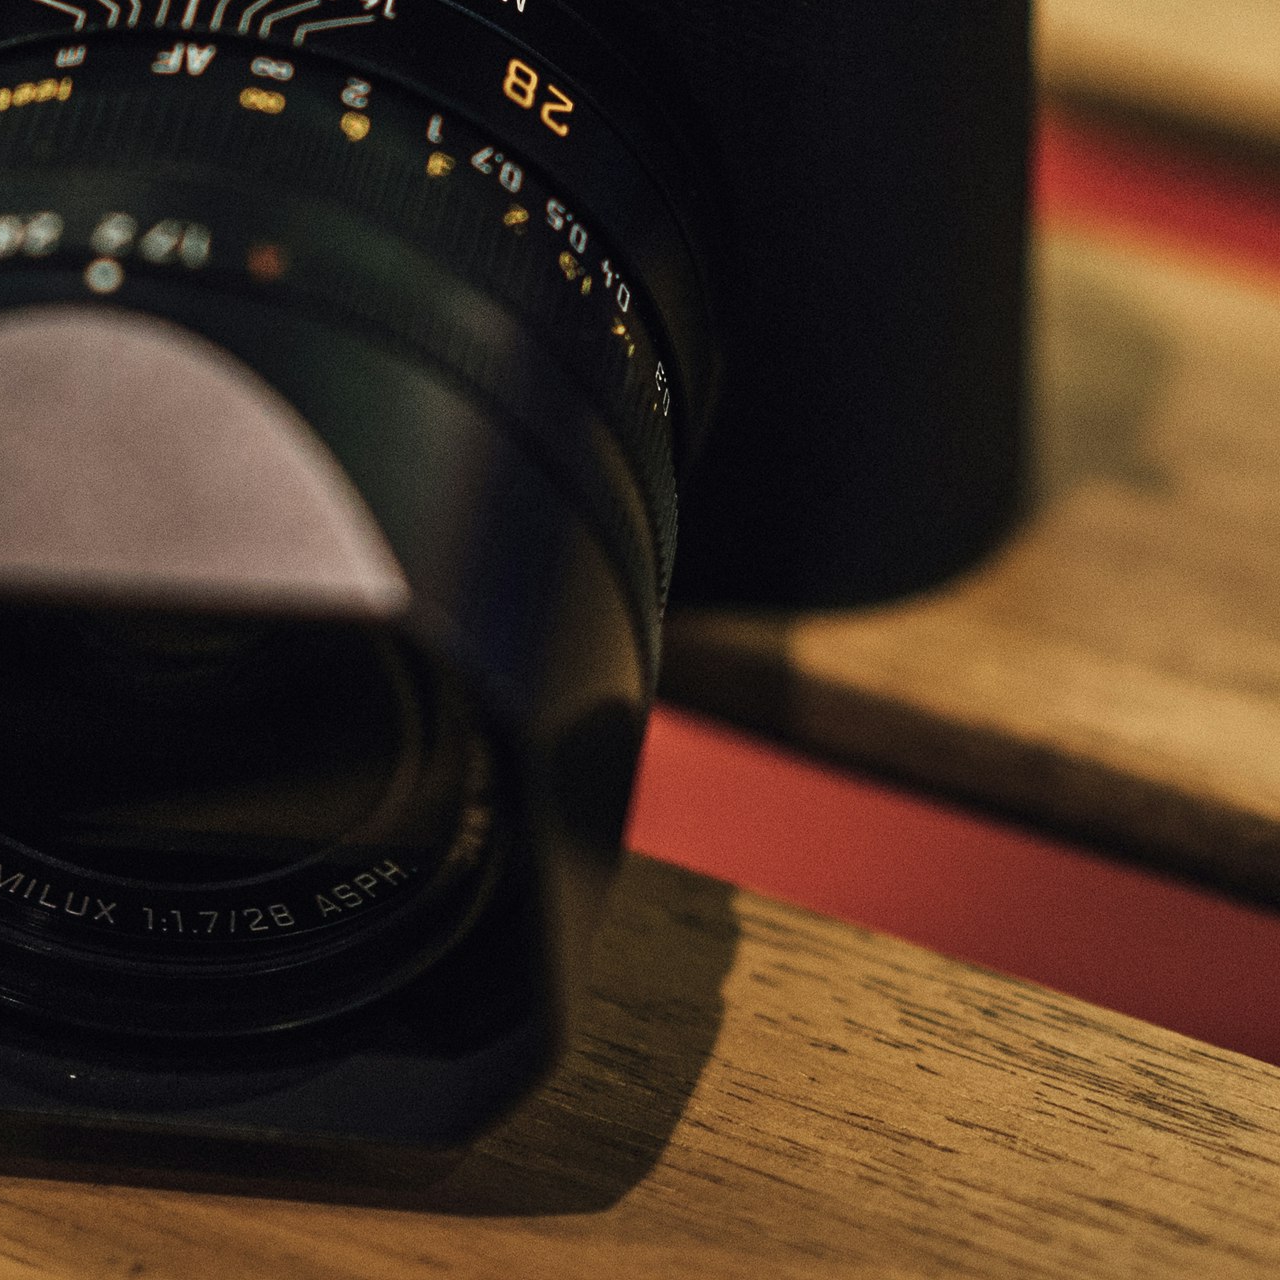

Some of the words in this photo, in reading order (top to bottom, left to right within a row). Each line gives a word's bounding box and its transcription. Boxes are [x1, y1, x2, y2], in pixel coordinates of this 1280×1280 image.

[152, 43, 217, 77] AF
[341, 78, 373, 110] 2
[501, 57, 576, 138] 28
[426, 114, 444, 145] 1
[470, 145, 525, 194] 0.7
[545, 197, 589, 255] 0.5
[141, 902, 296, 935] 1:1.7/28
